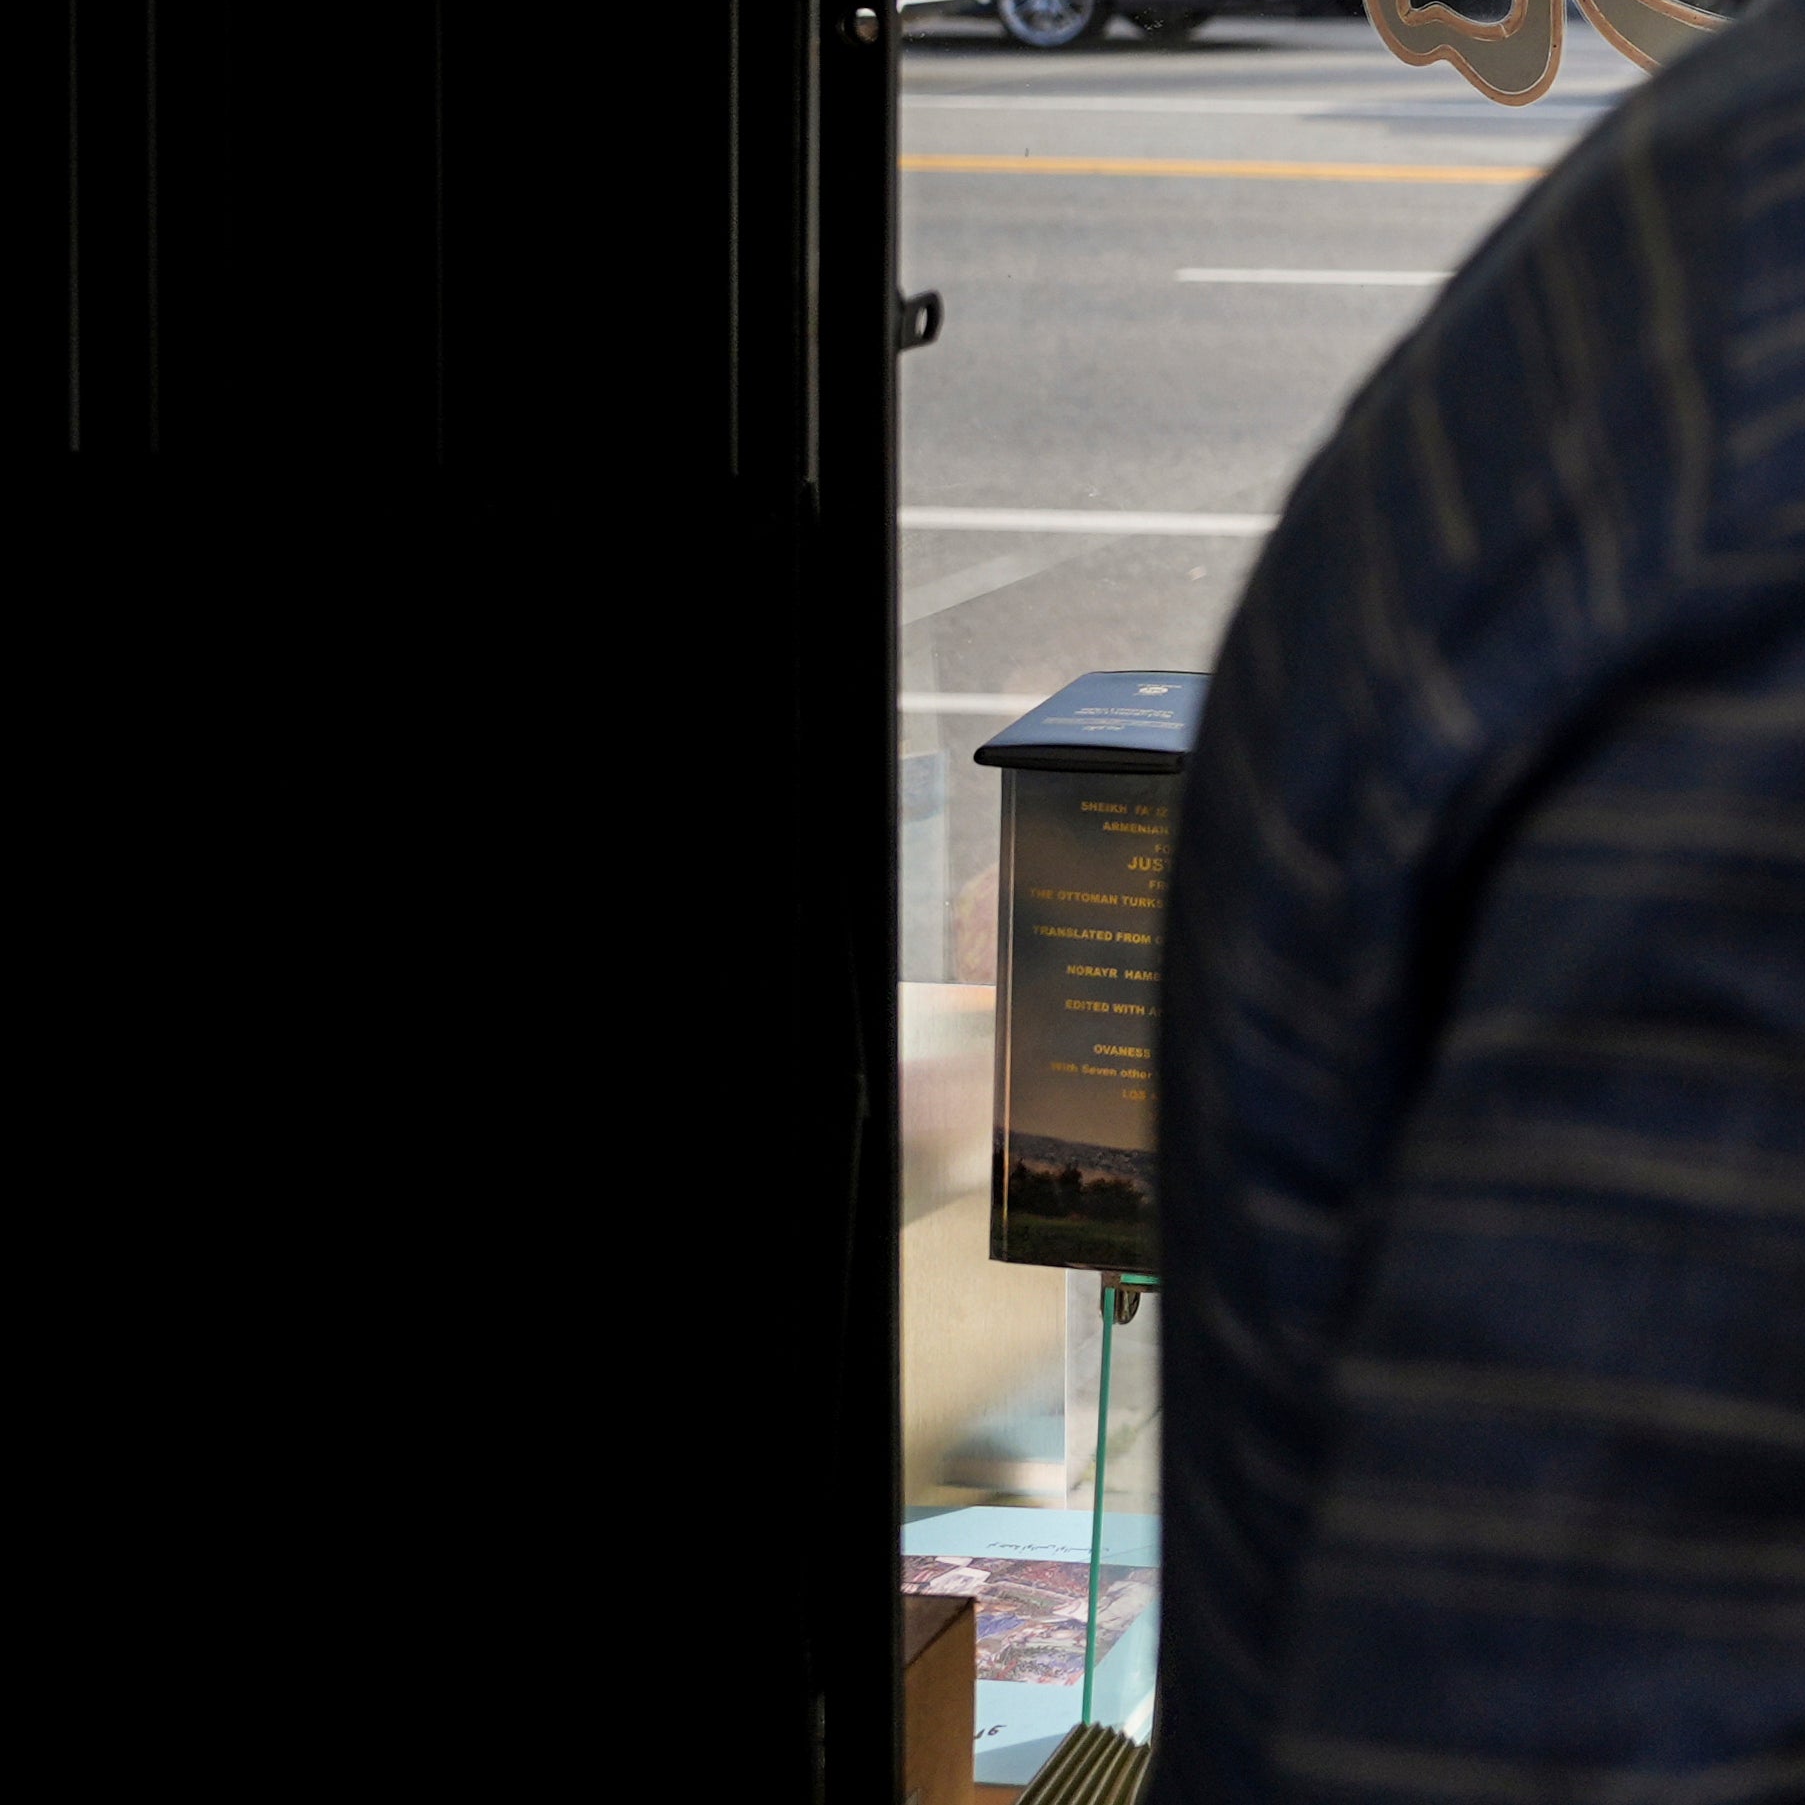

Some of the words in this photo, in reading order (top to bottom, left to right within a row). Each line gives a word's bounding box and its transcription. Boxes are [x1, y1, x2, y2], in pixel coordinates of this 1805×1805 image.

[1080, 800, 1128, 814] SHEIKH
[1127, 856, 1169, 872] JUS
[1057, 890, 1118, 905] OTTOMAN
[1033, 925, 1113, 942] TRANSLATED
[1116, 931, 1152, 944] FROM
[1066, 965, 1118, 979] NORAYR
[1065, 999, 1110, 1013] EDITED
[1113, 1003, 1145, 1015] WITH
[1093, 1044, 1152, 1059] OVANESS
[1082, 1064, 1117, 1076] Seven
[1120, 1067, 1152, 1079] other
